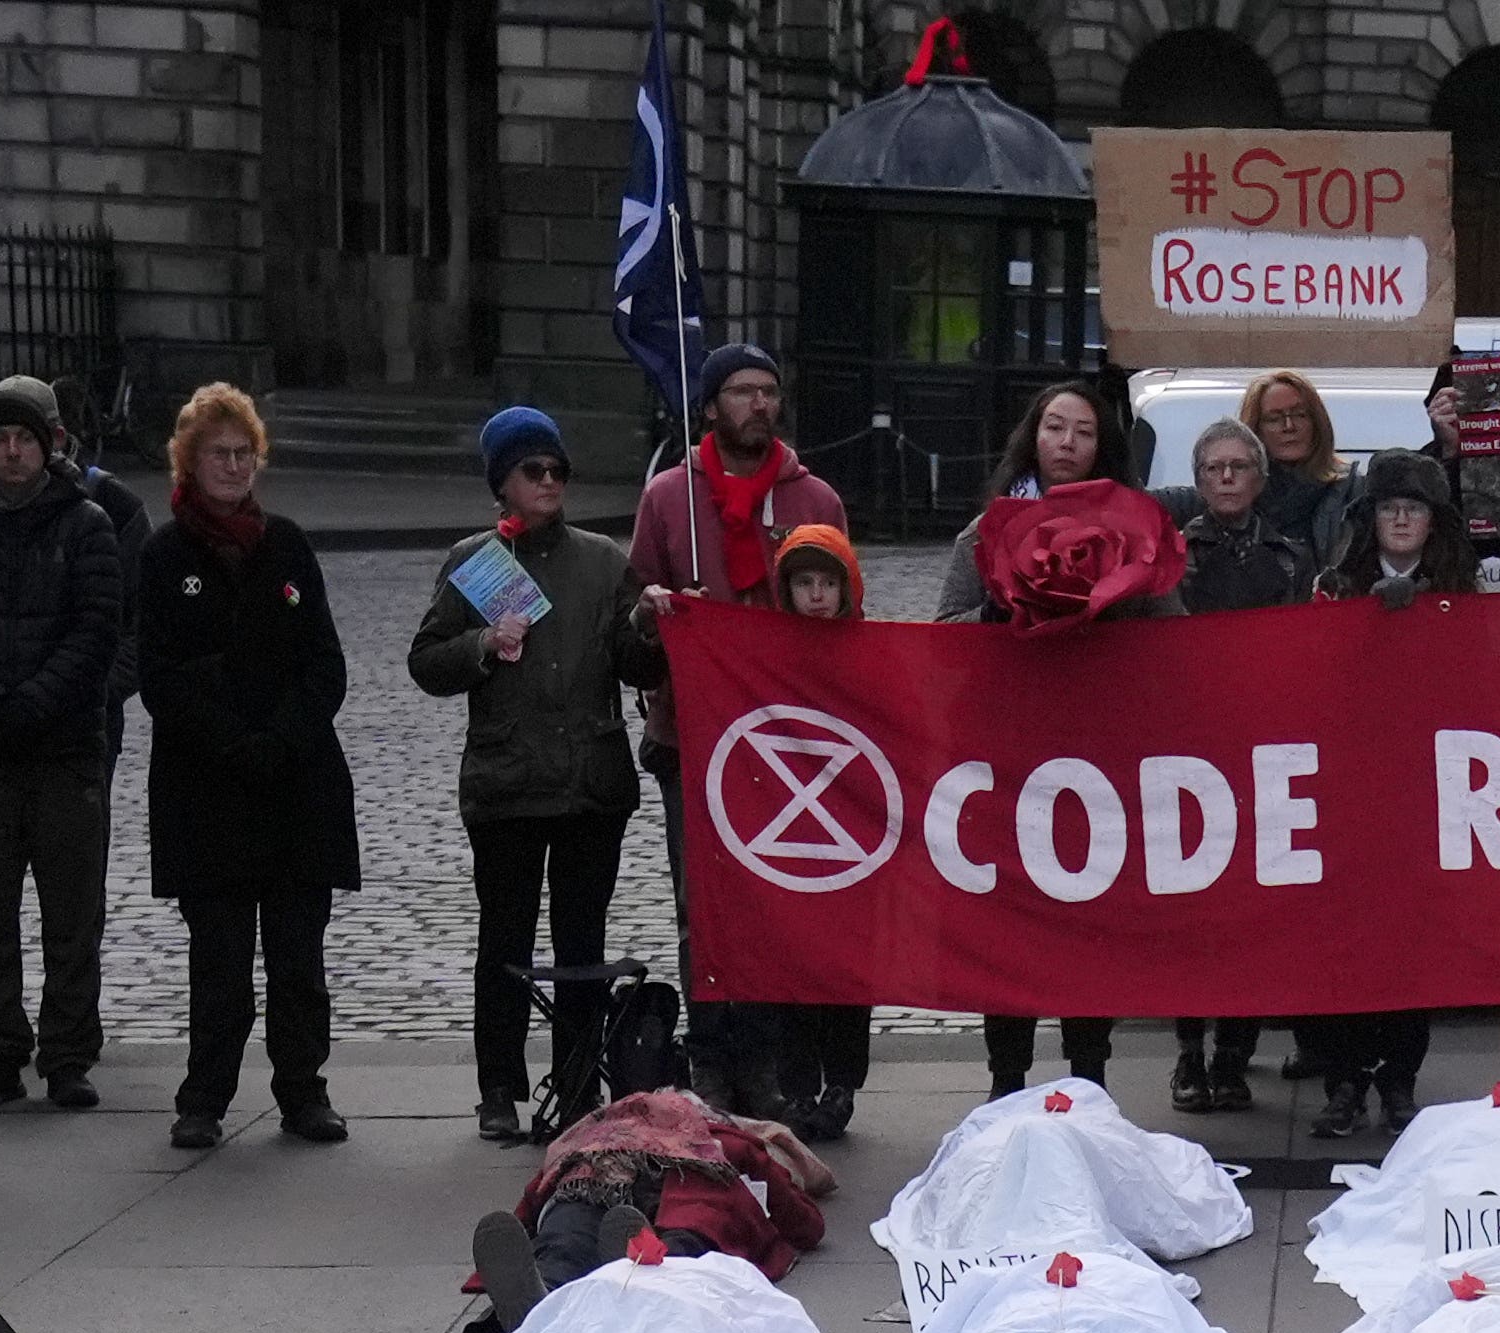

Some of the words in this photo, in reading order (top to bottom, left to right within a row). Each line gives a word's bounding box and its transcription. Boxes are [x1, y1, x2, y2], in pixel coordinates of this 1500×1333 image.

[1170, 147, 1405, 233] #STOP
[1163, 239, 1404, 306] ROSEBANK
[1452, 361, 1489, 373] Extreme
[1459, 418, 1499, 432] Brought
[1460, 440, 1492, 451] Ithaca
[923, 742, 1324, 903] CODE
